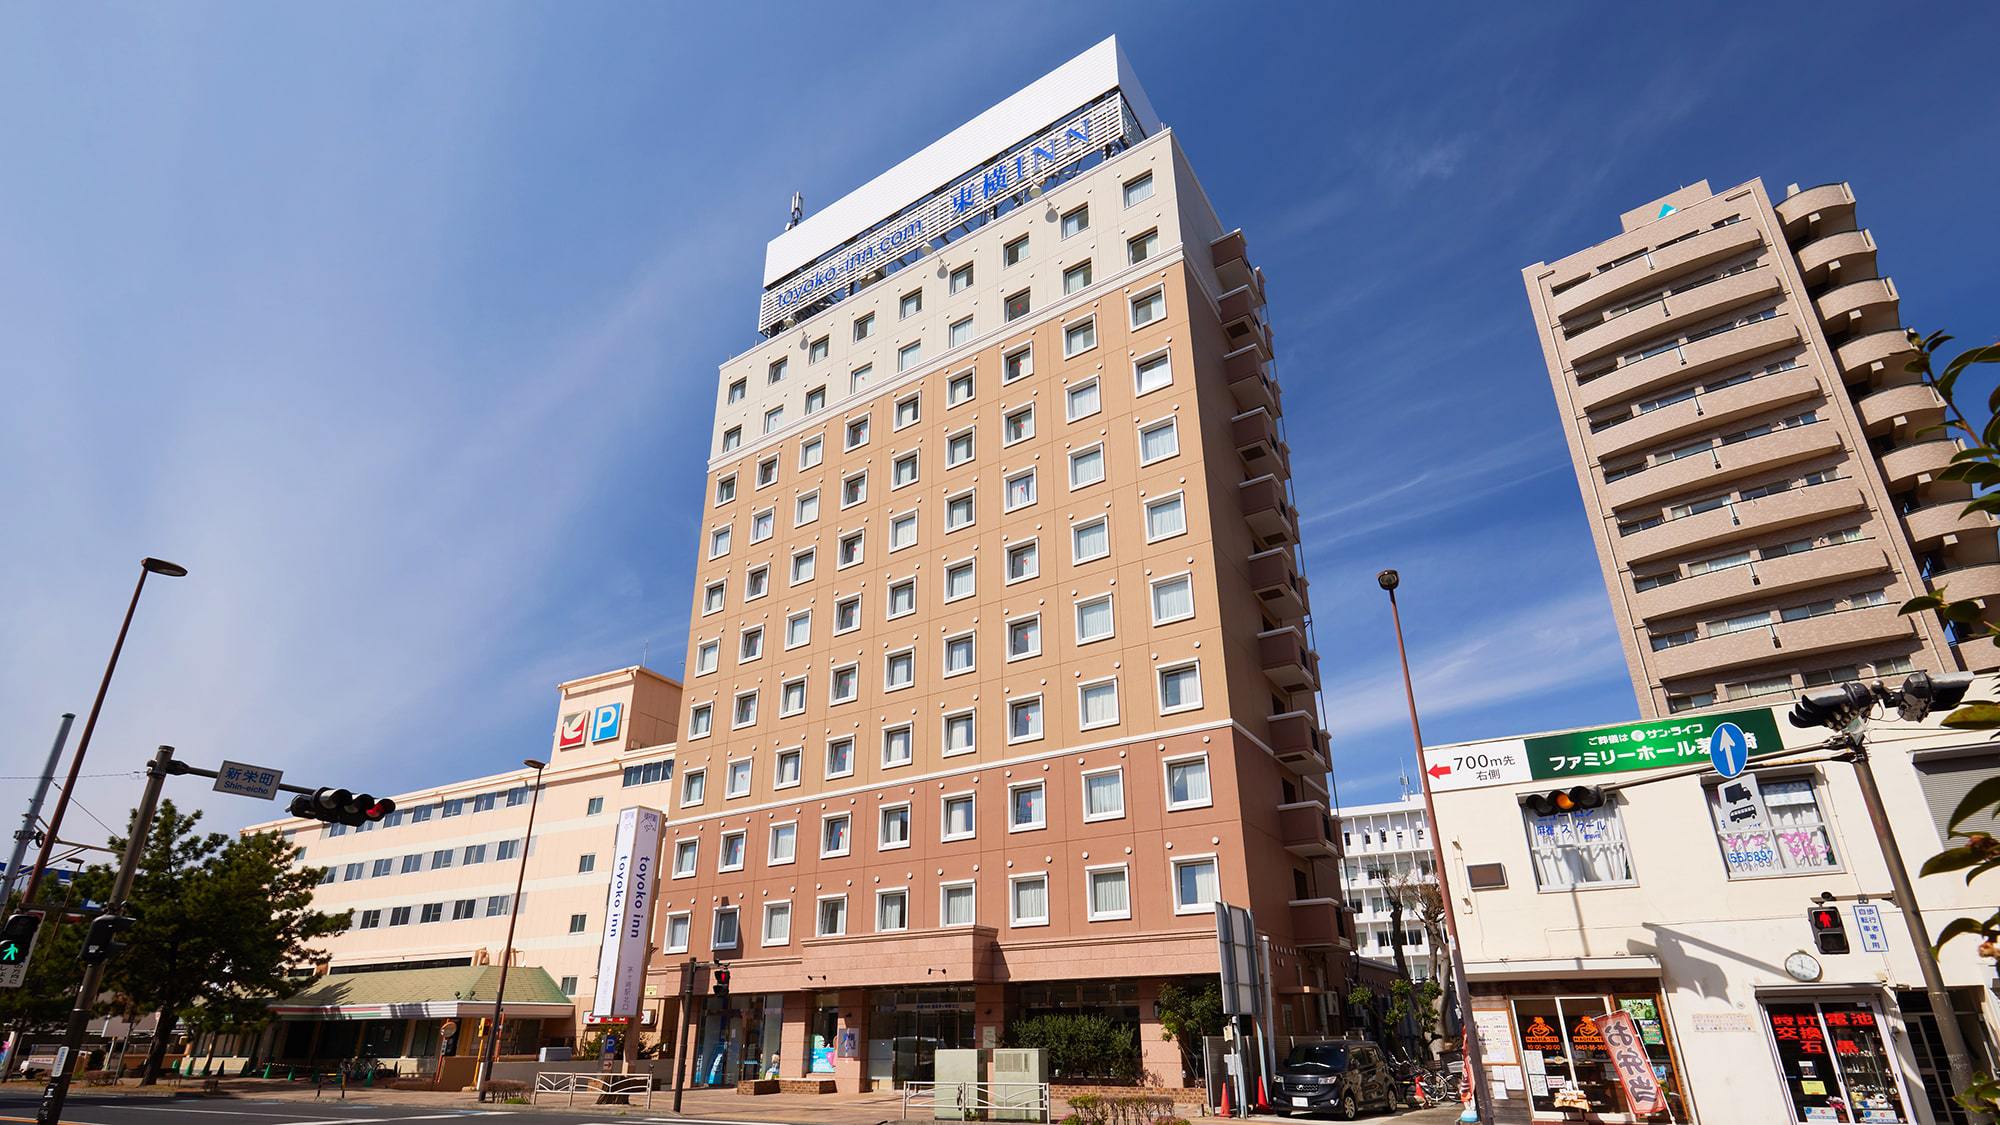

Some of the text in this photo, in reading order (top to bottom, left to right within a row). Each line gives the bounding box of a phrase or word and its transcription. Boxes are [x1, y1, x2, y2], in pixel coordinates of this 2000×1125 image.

[952, 118, 1090, 215] 東横INN
[595, 707, 617, 740] P
[1453, 754, 1516, 772] 700m先
[1549, 732, 1758, 772] ファミリーホール茅崎
[225, 766, 275, 787] 新栄町
[1476, 769, 1501, 782] 右側
[609, 855, 628, 937] toyoko inn
[630, 856, 651, 938] toyoko inn
[1775, 1027, 1823, 1039] 交換
[1604, 1021, 1657, 1103] お弁当
